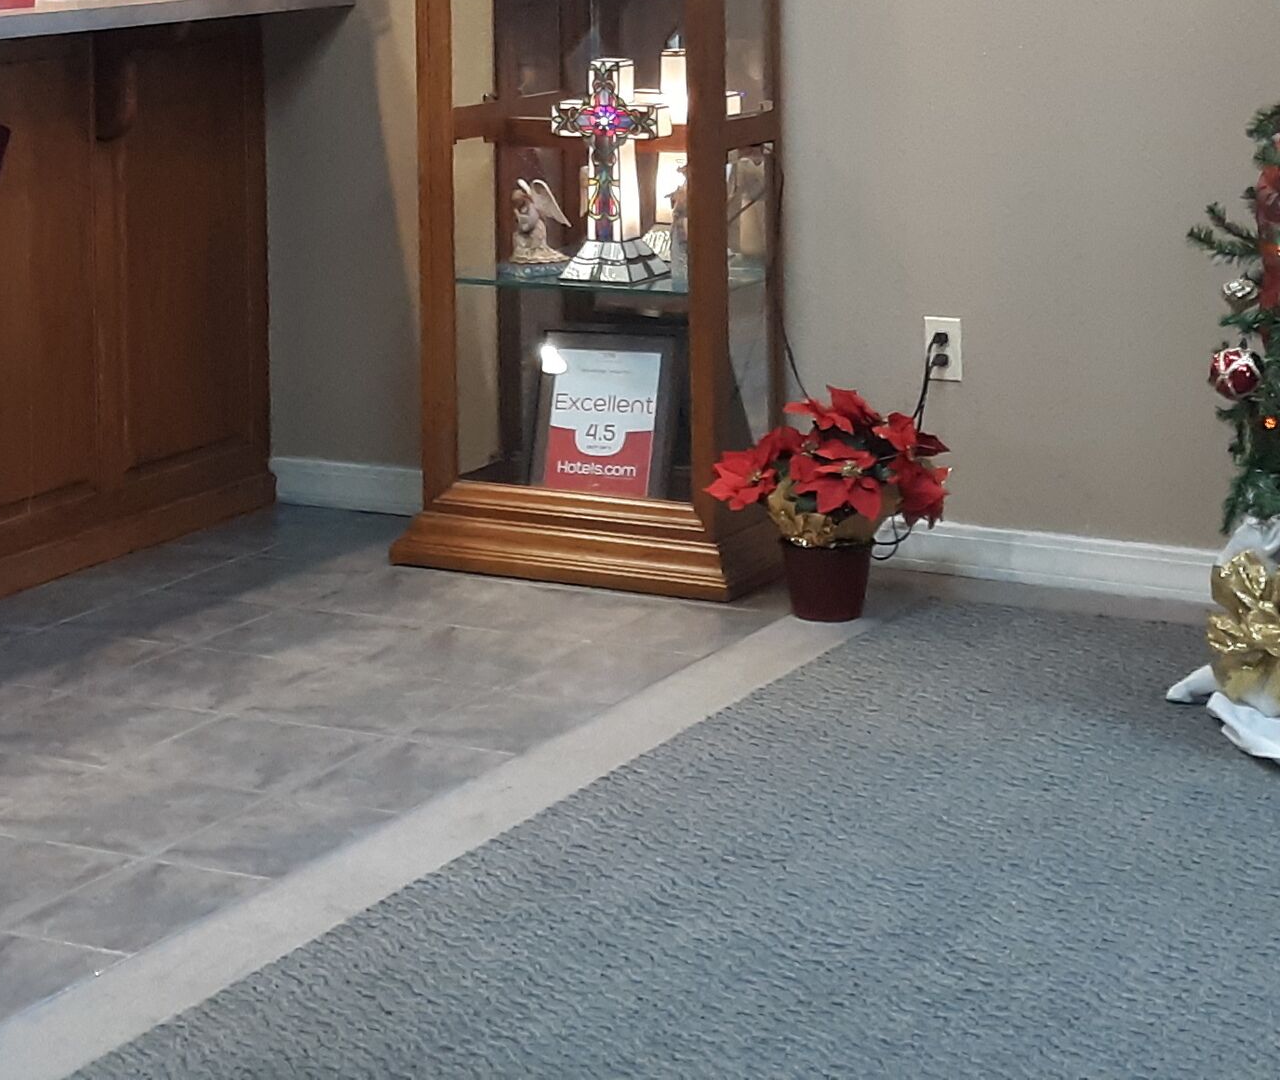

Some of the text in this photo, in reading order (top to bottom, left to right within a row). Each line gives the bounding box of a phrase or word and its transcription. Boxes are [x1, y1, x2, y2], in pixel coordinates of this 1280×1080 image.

[555, 393, 653, 414] Excellent
[585, 424, 615, 441] 4.5
[557, 460, 636, 477] Hotels.com
